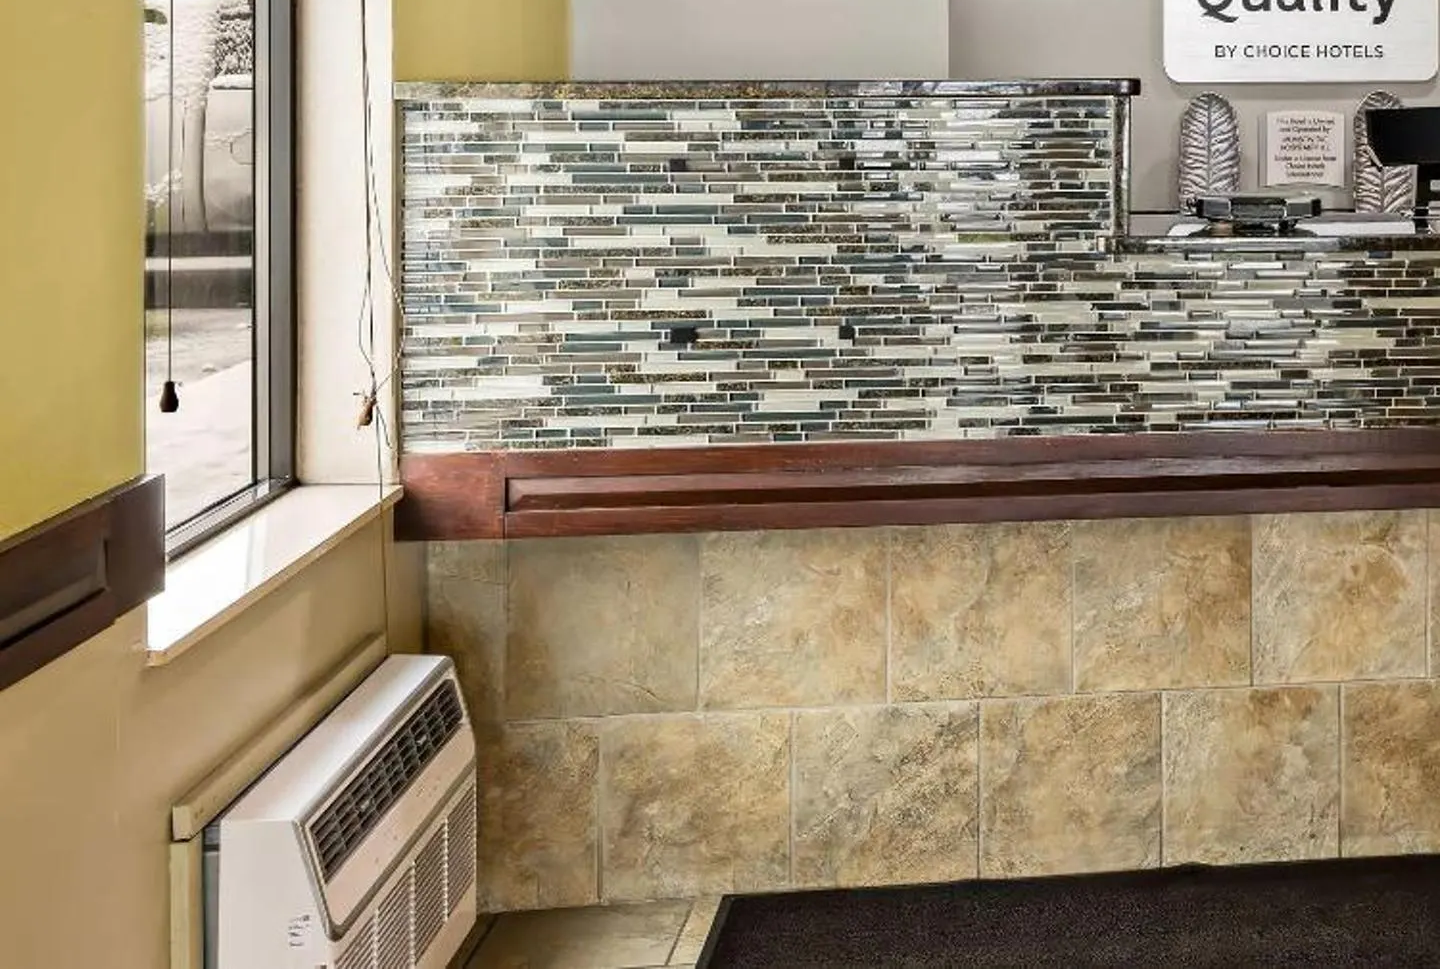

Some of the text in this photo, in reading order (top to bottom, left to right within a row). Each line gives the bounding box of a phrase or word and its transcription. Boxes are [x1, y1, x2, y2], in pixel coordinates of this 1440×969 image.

[1214, 44, 1384, 59] BY CHOICE HOTELS
